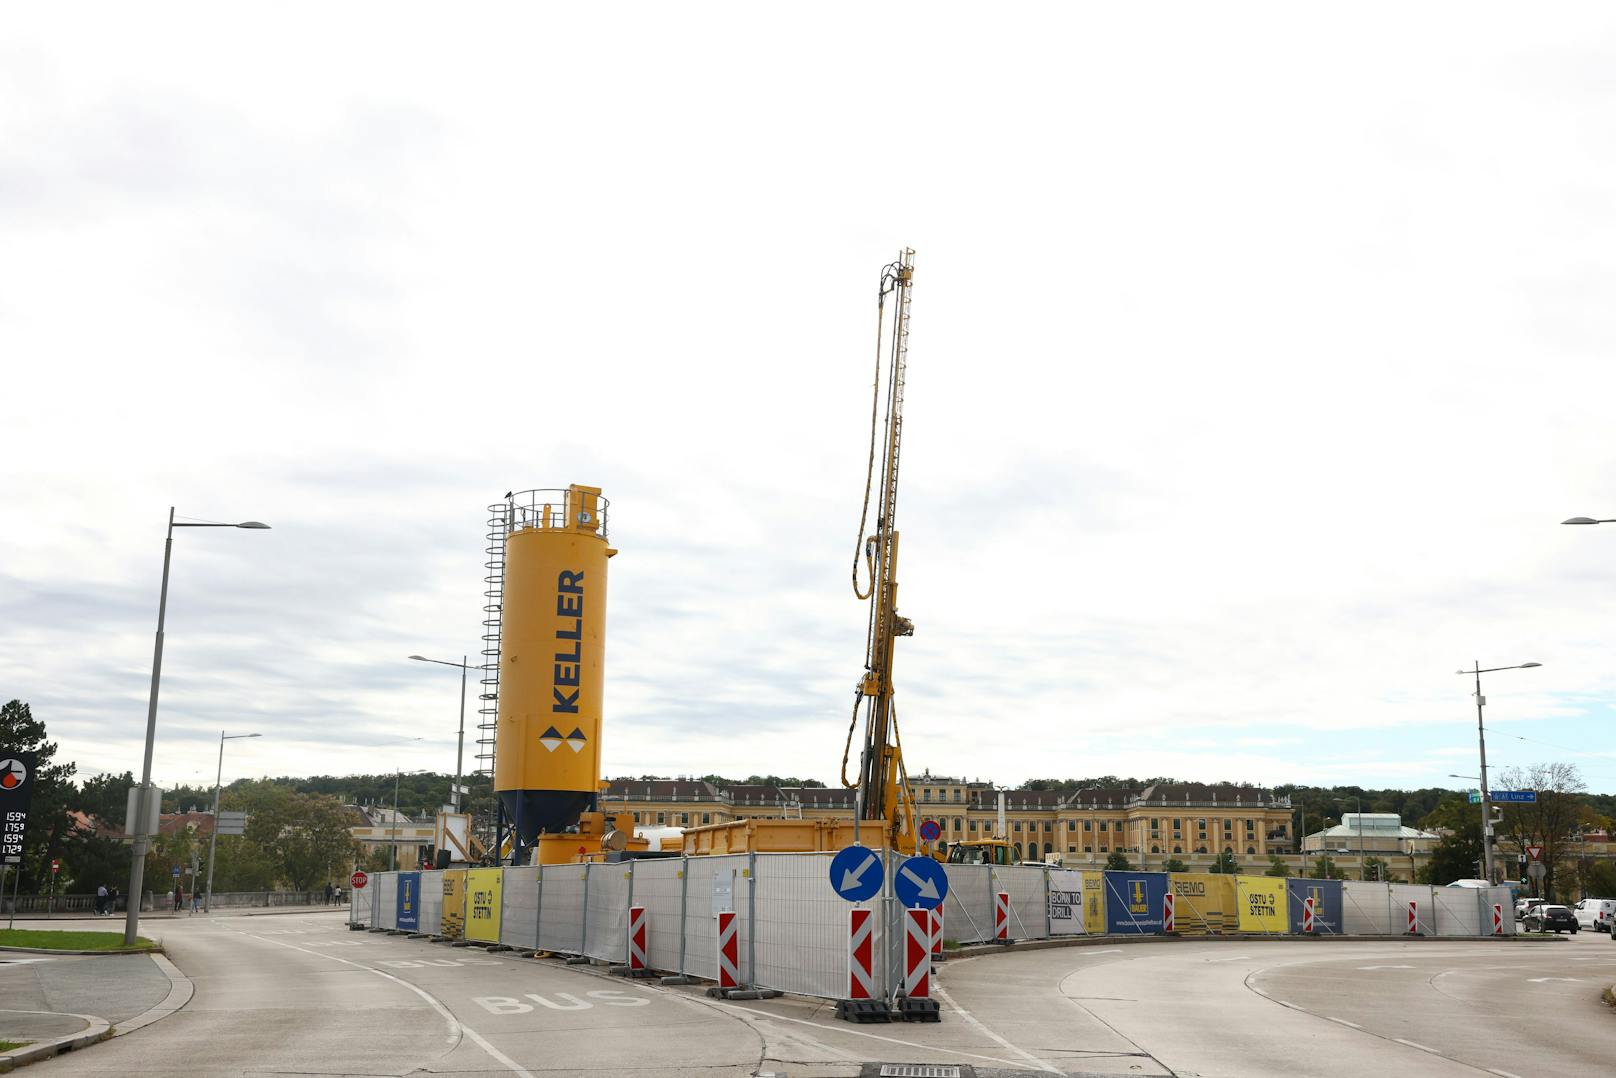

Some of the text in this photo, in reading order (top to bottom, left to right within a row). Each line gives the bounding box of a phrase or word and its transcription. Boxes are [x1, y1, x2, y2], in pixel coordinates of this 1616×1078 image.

[552, 569, 585, 714] KELLER
[351, 876, 368, 885] STOP
[1174, 881, 1205, 893] BEMO
[1052, 891, 1071, 904] BORN
[1071, 893, 1081, 904] TO
[473, 906, 492, 919] STETTIN
[1052, 906, 1072, 918] DRILL
[1250, 906, 1275, 917] STETTIN
[472, 989, 650, 1015] BUS
